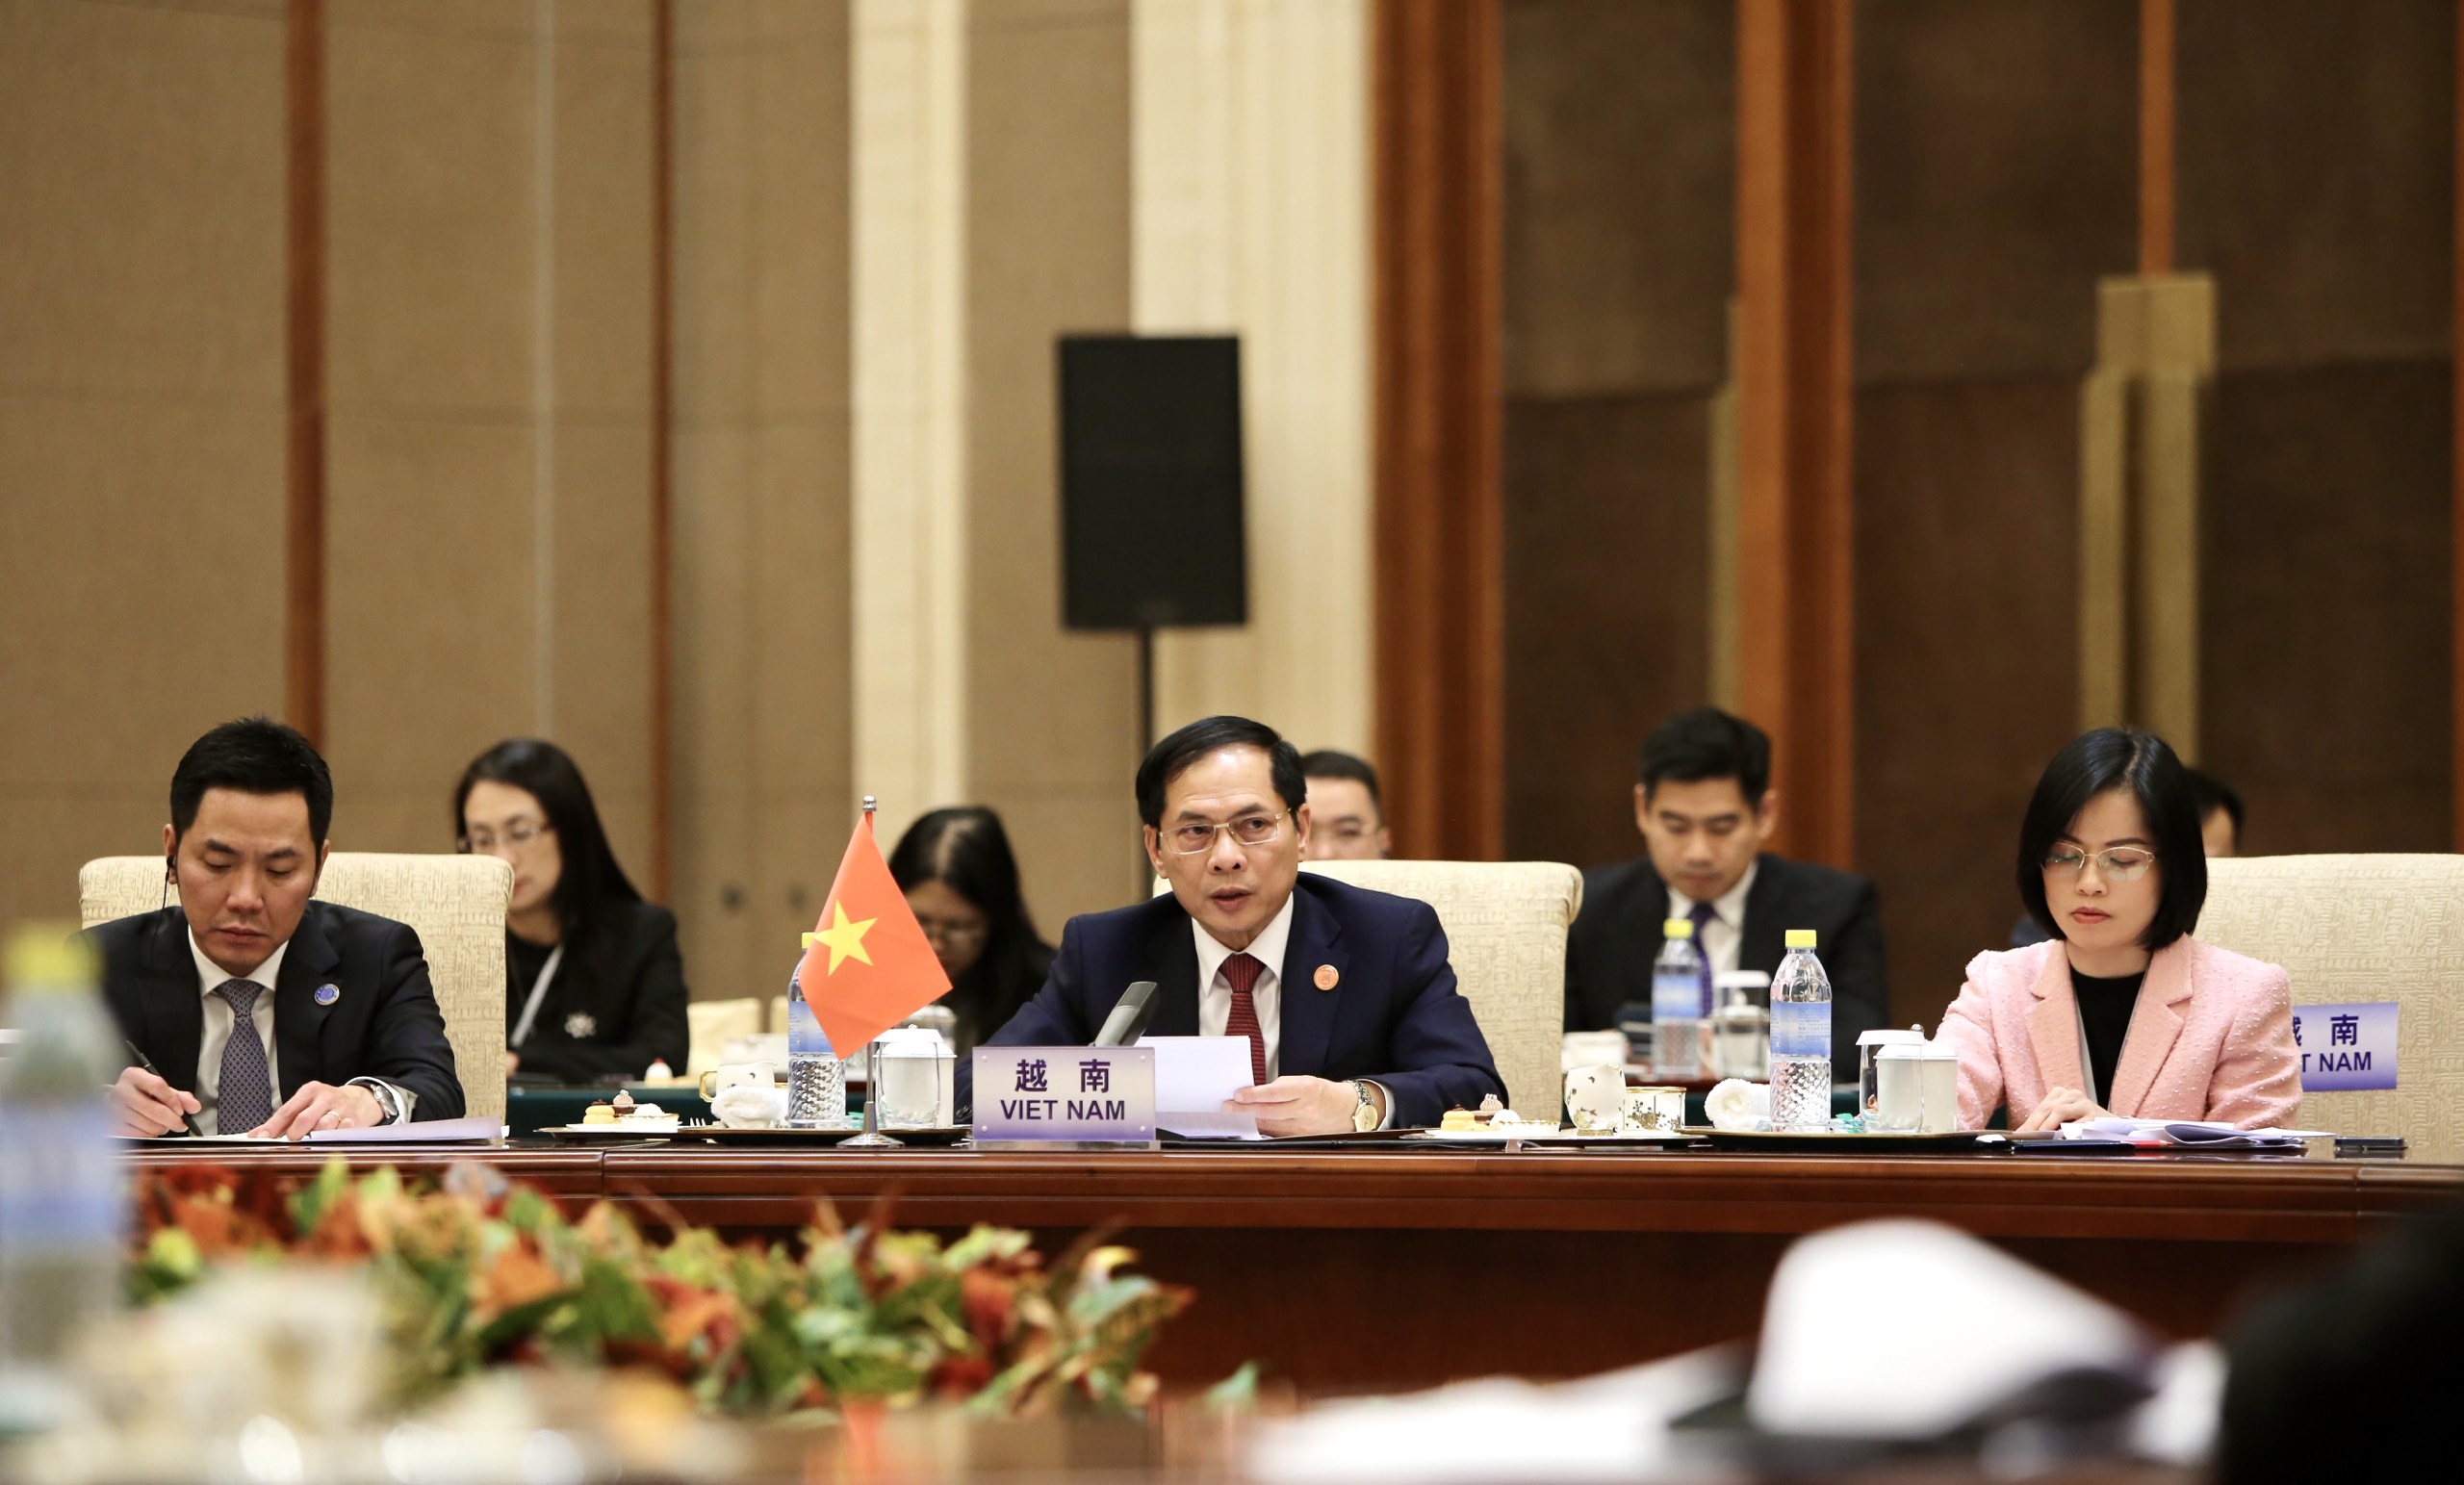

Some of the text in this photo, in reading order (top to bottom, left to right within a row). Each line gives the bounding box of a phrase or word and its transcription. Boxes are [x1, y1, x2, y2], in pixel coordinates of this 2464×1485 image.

[2319, 1051, 2372, 1072] NAM
[1014, 1059, 1111, 1093] 越南
[1000, 1099, 1125, 1120] VIET NAM
